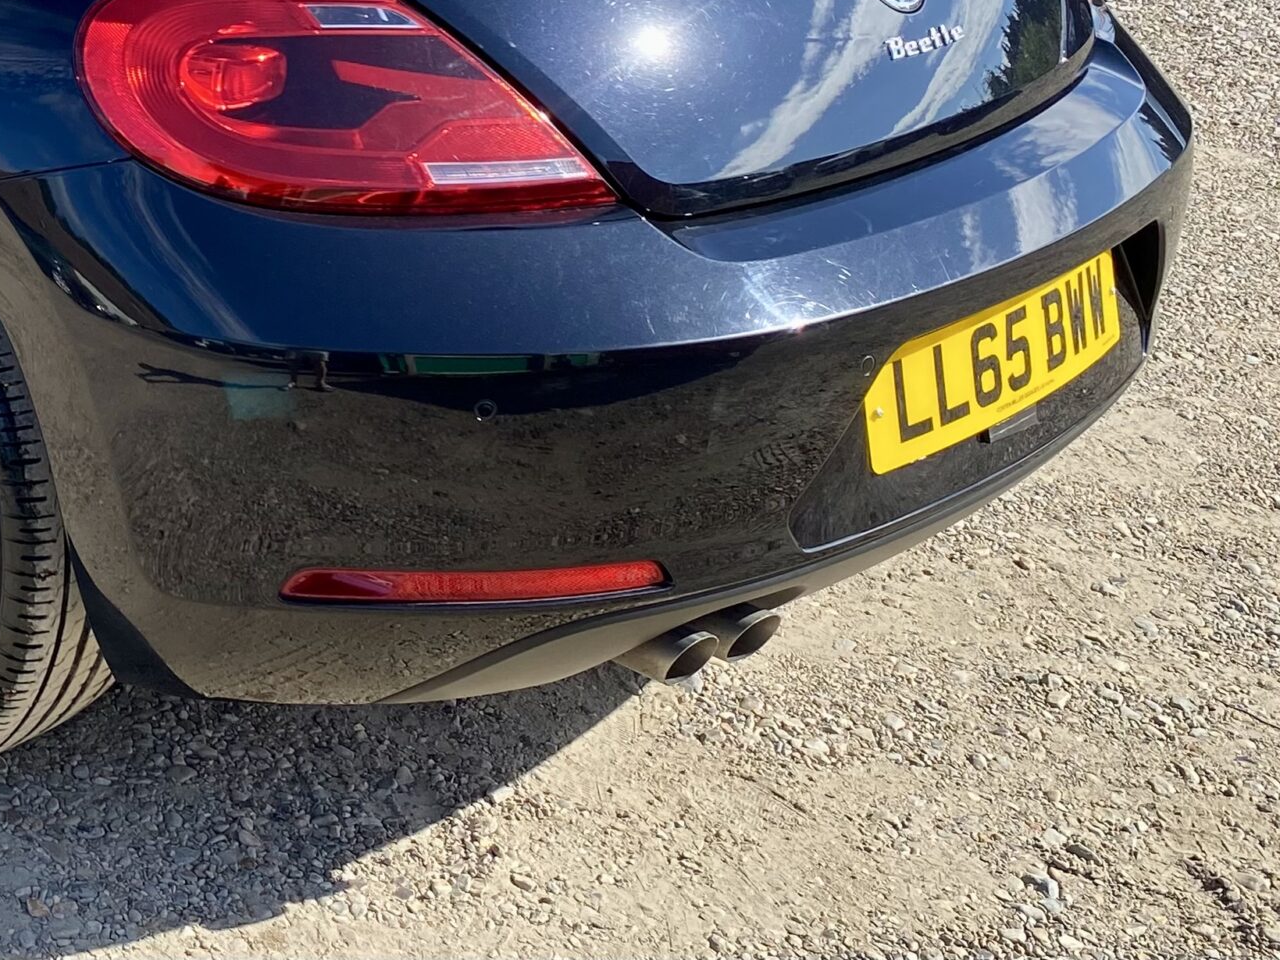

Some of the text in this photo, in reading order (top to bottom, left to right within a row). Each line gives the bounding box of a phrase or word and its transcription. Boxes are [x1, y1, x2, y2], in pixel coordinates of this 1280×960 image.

[883, 23, 966, 61] Beetle
[892, 257, 1107, 444] LL65 BWW
